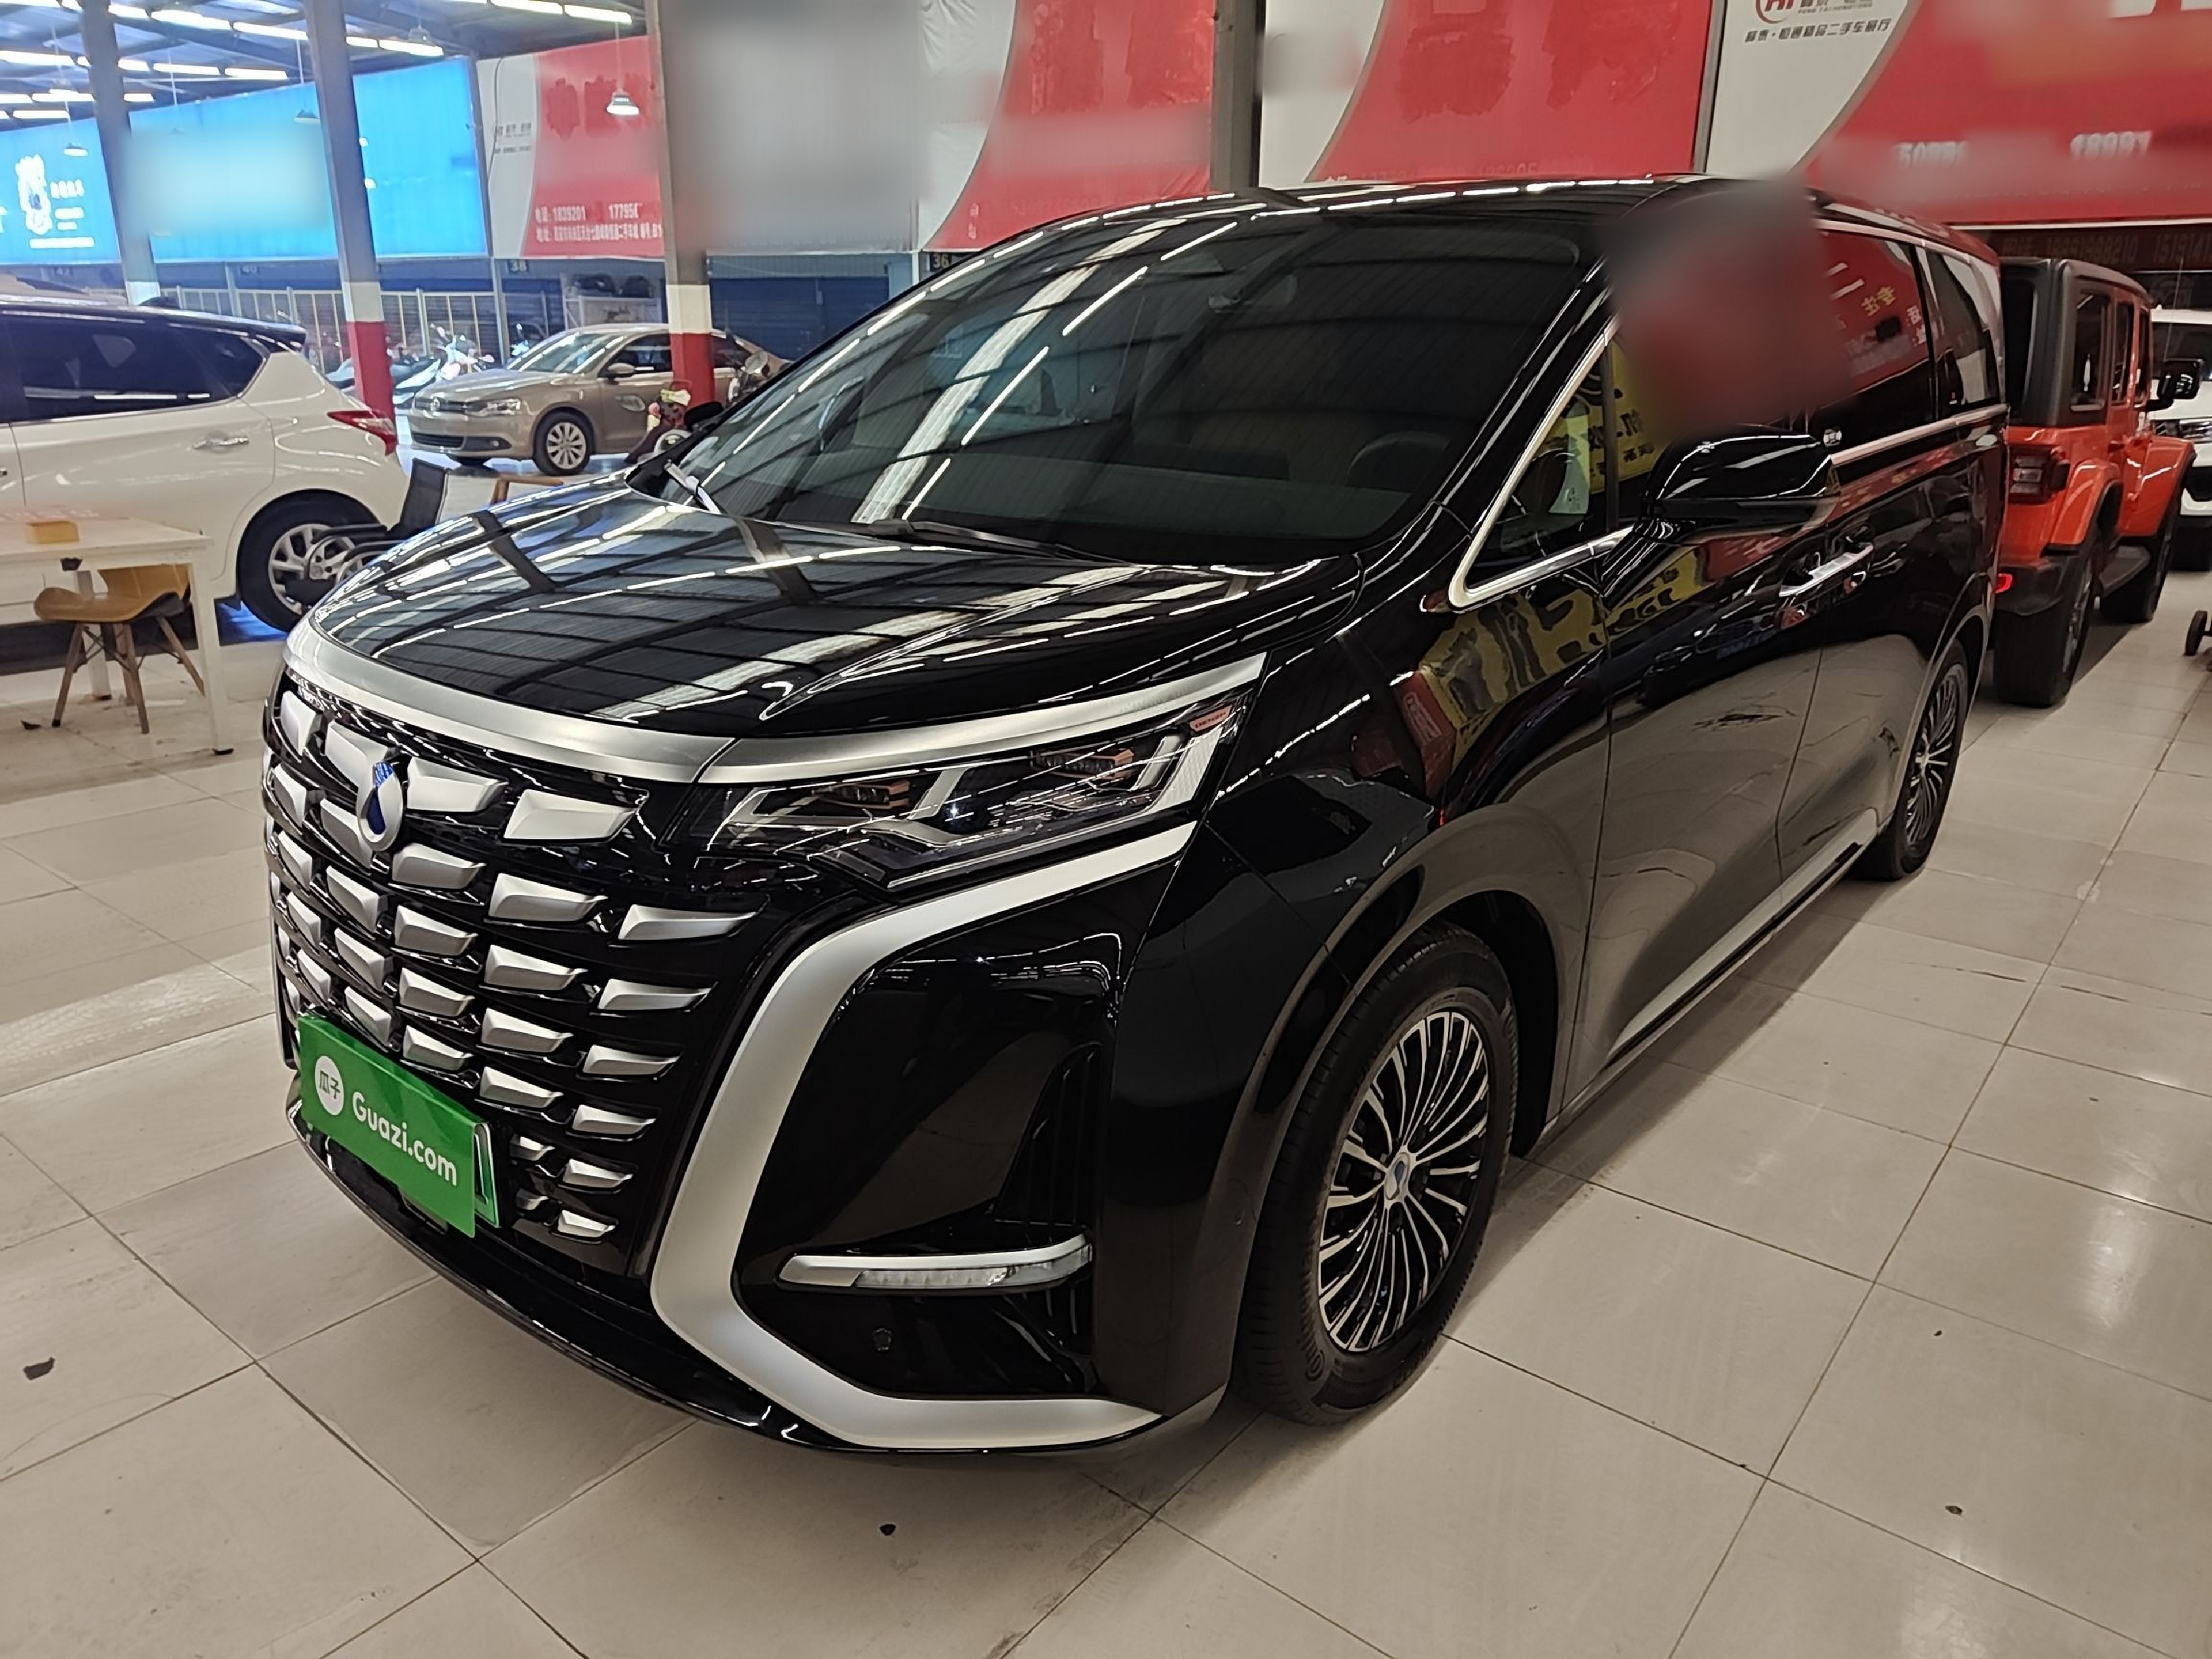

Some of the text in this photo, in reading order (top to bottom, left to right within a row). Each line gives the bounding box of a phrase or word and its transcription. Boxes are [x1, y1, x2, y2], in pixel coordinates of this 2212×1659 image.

[933, 253, 950, 268] 36
[317, 1069, 341, 1100] 瓜子
[352, 1091, 458, 1187] Guazi.com
